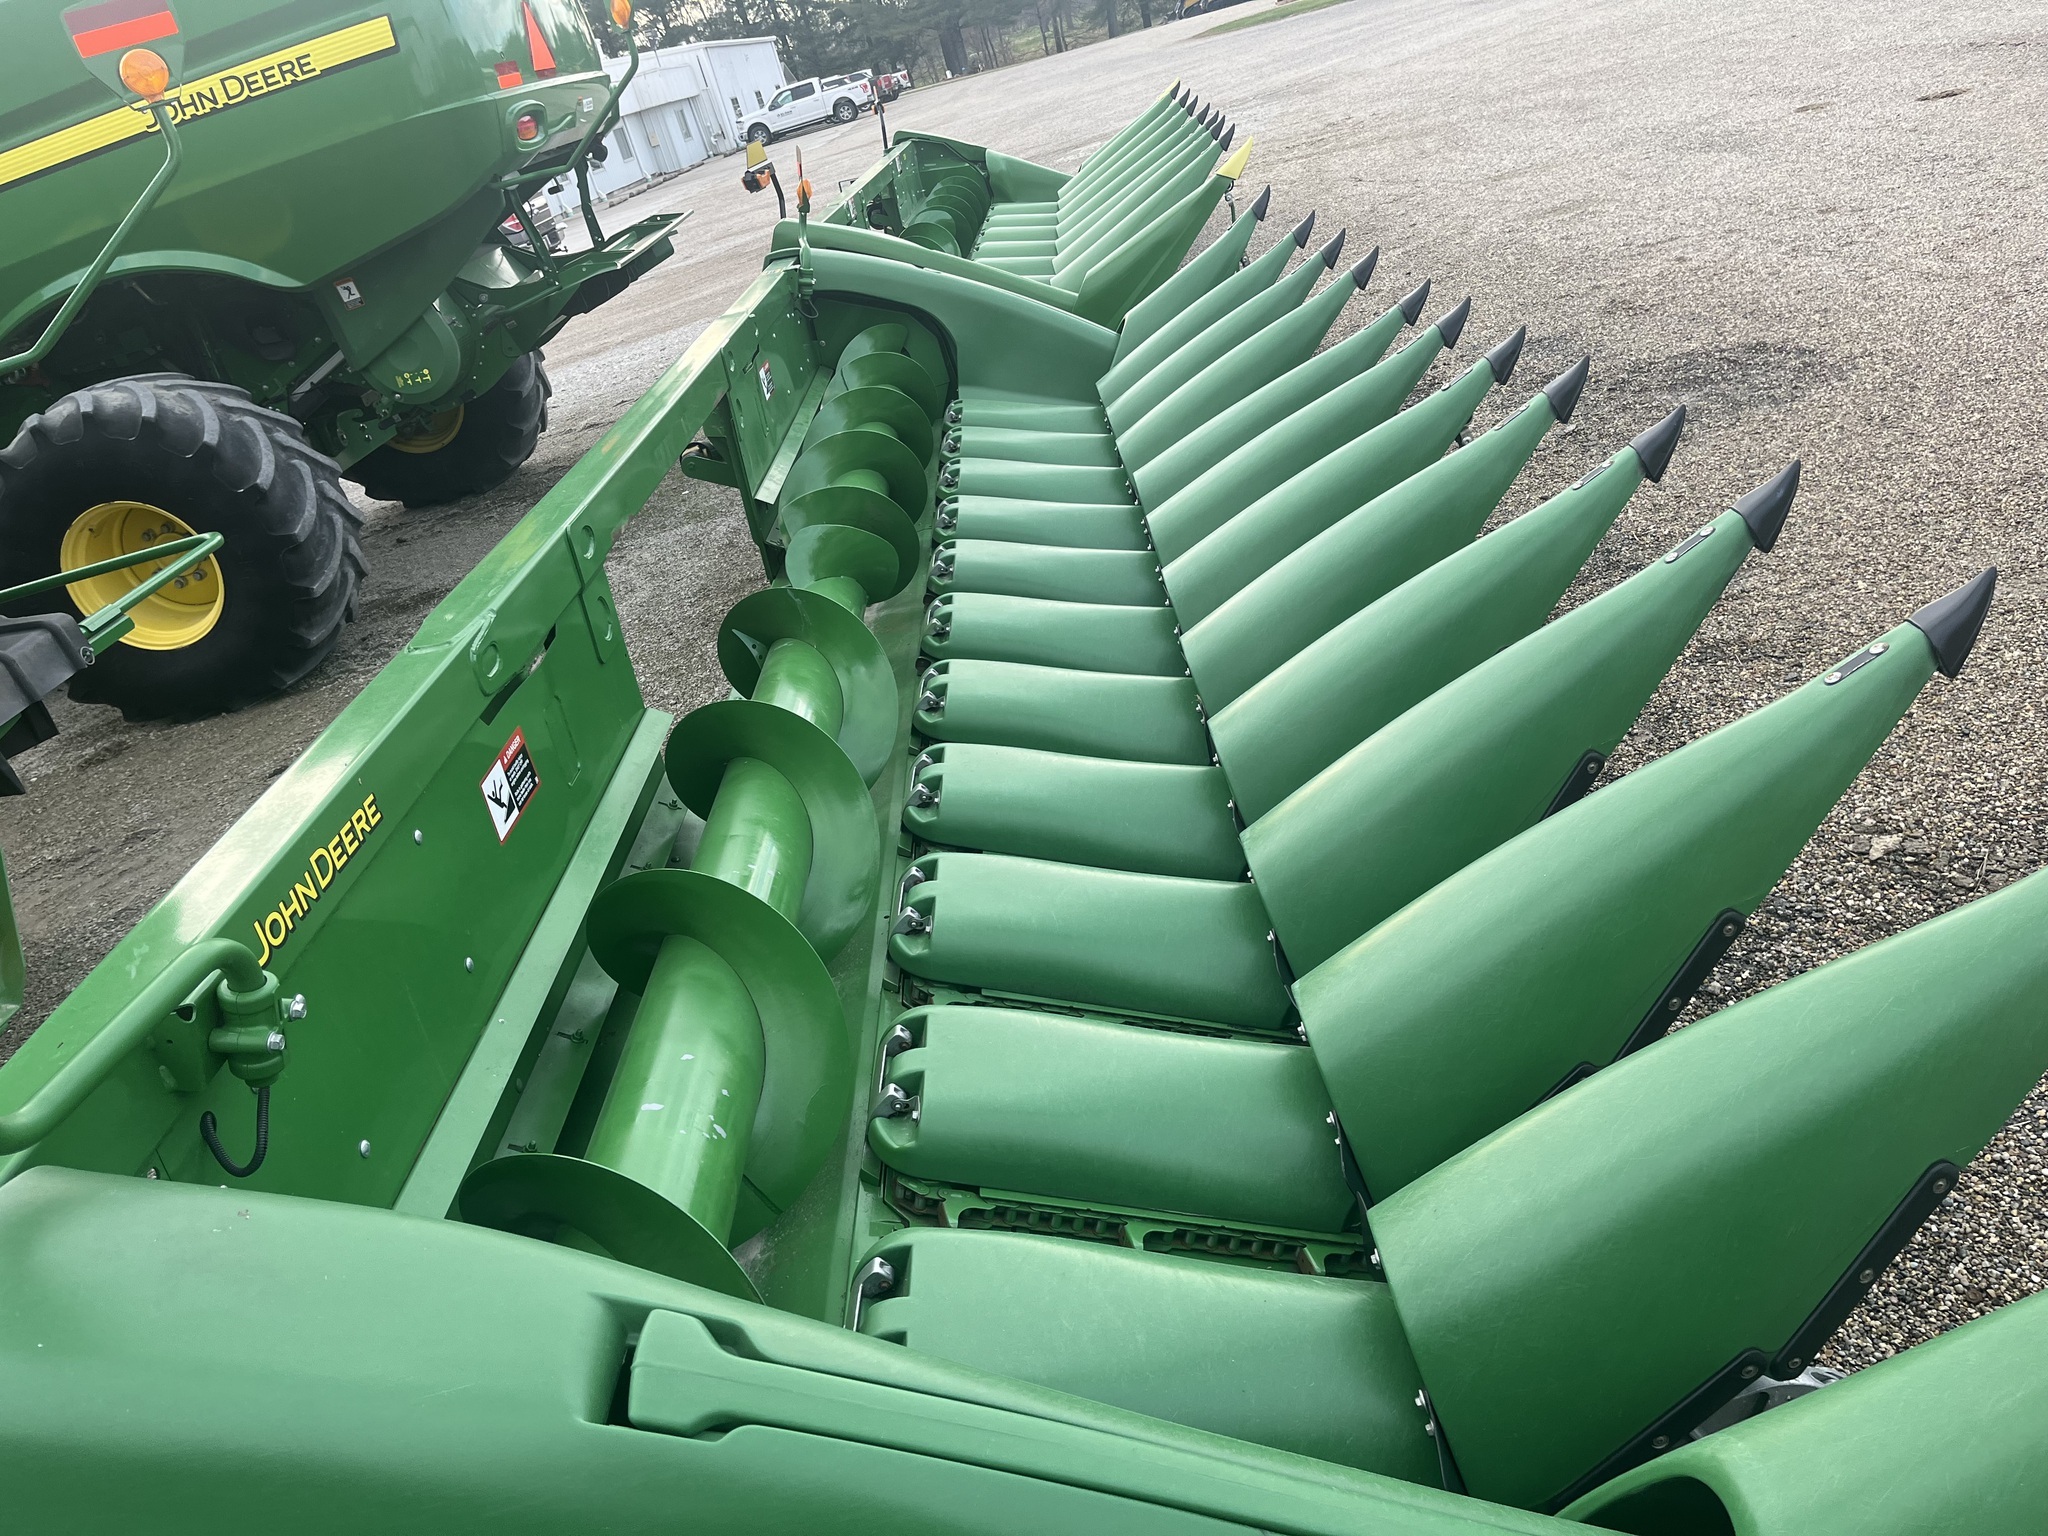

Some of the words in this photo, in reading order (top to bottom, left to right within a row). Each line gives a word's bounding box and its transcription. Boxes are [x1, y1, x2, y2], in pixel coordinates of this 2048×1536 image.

[219, 53, 317, 101] DEERE
[254, 871, 319, 967] JOHN
[309, 793, 382, 891] DEERE
